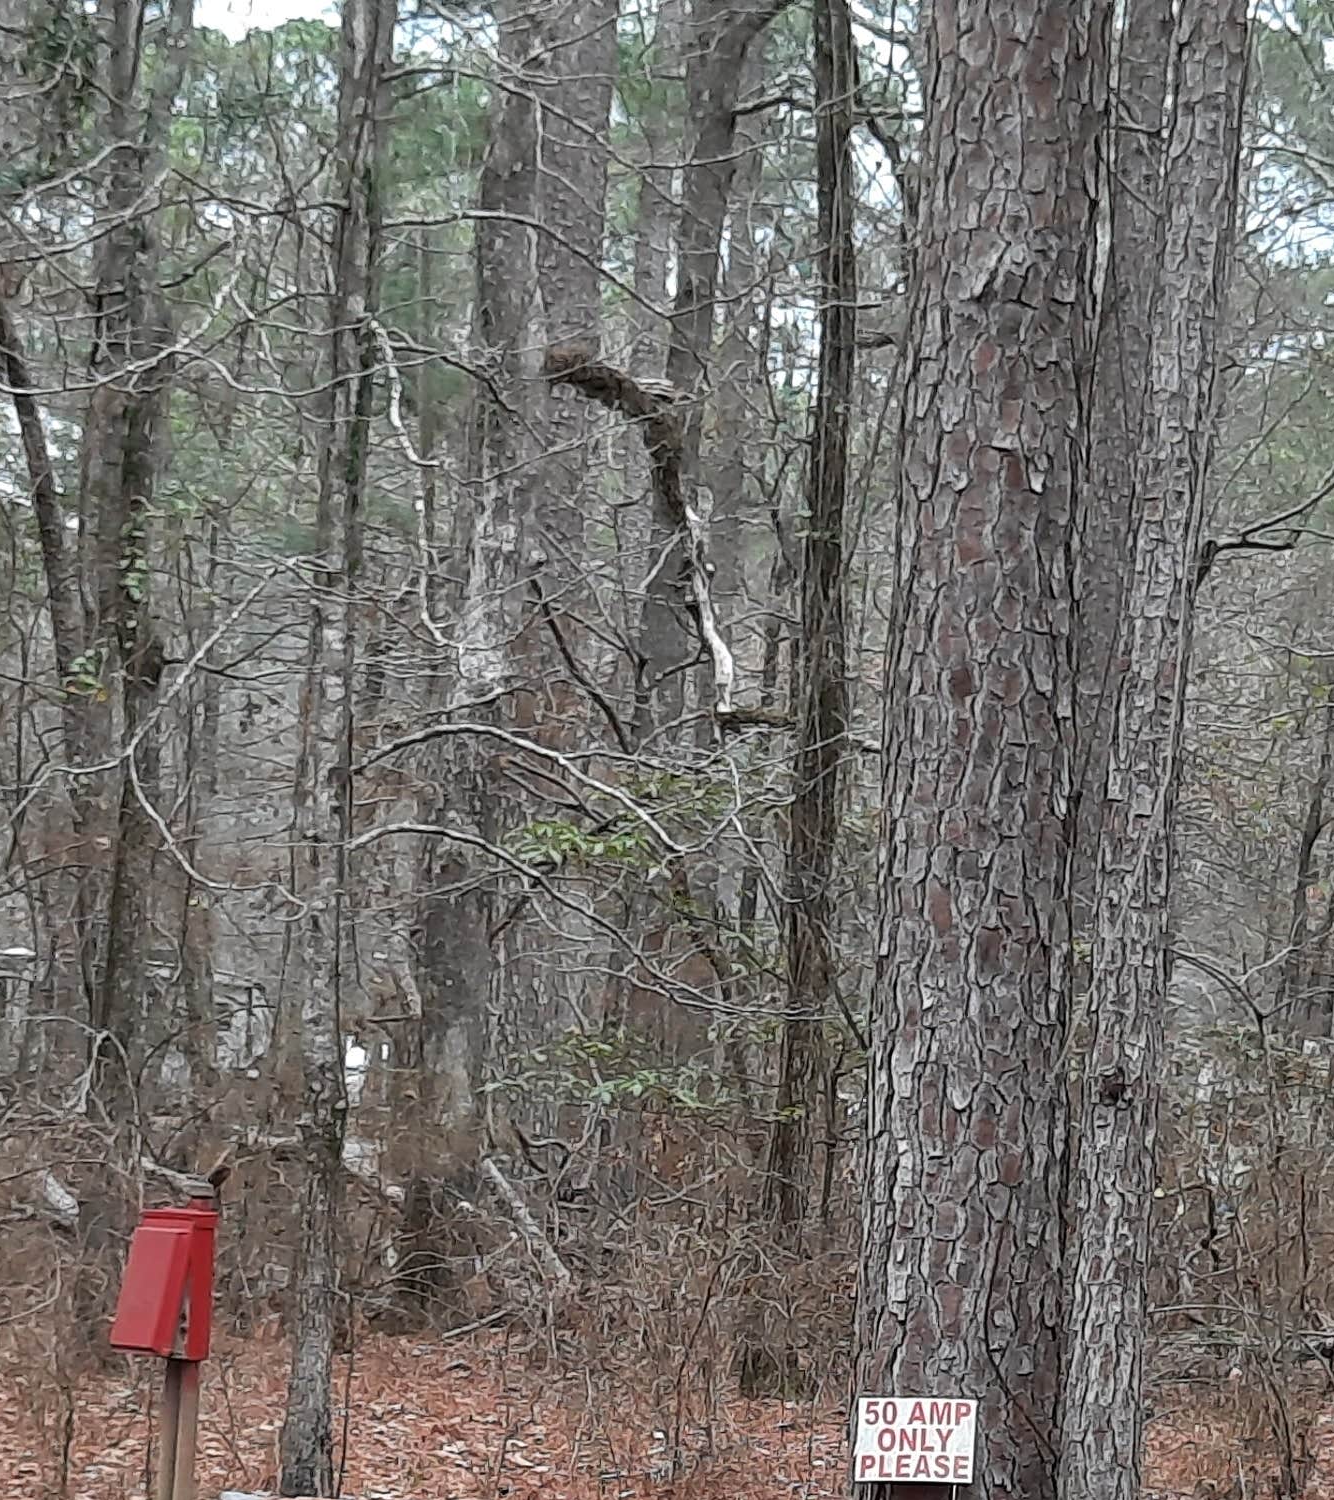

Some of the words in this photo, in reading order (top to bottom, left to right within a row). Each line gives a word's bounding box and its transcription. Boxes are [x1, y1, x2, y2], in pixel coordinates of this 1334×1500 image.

[865, 1401, 897, 1425] 50
[907, 1401, 972, 1426] AMP
[877, 1428, 954, 1452] ONLY
[859, 1454, 969, 1480] PLEASE
